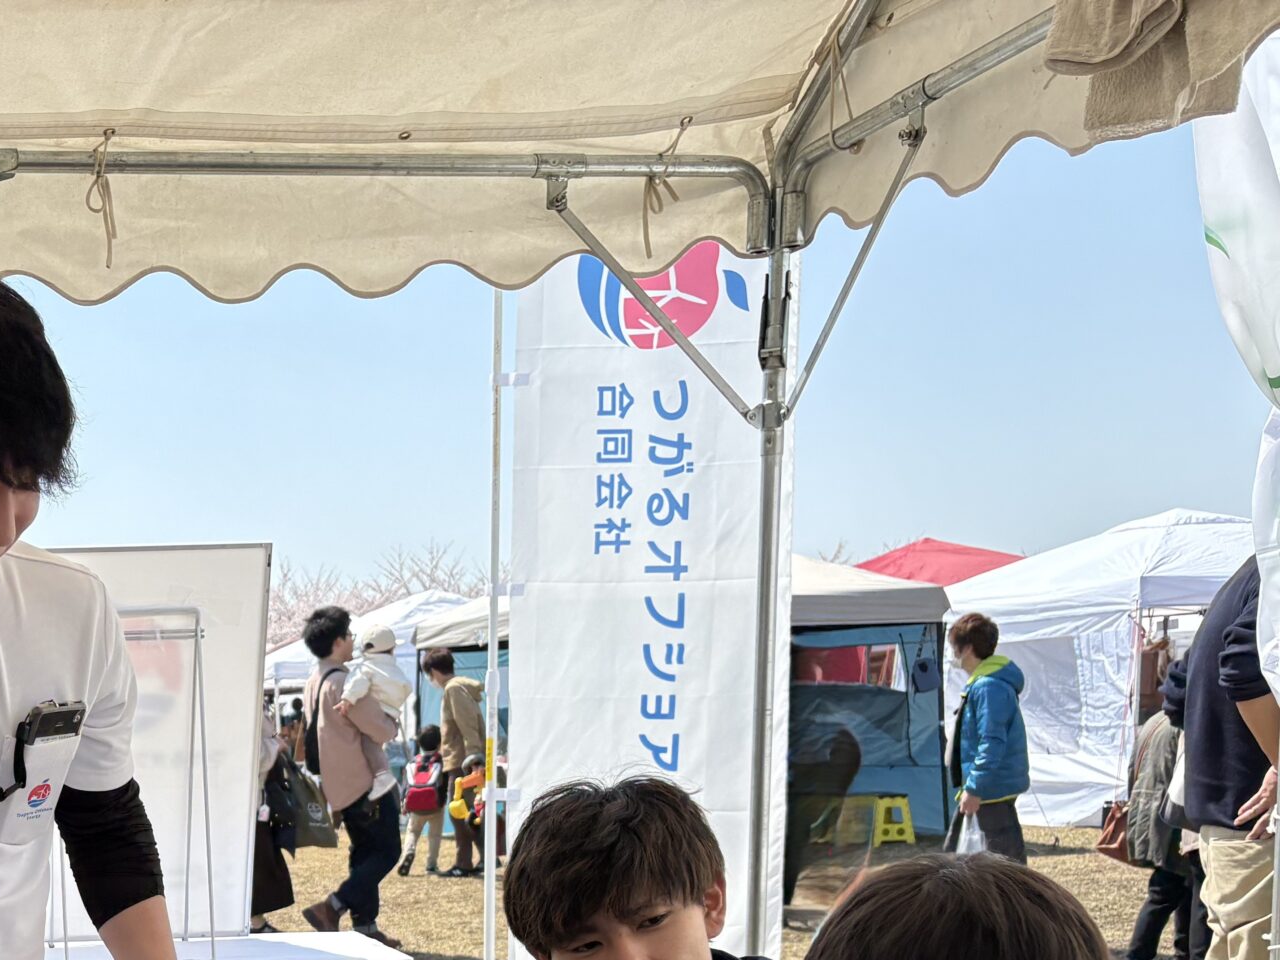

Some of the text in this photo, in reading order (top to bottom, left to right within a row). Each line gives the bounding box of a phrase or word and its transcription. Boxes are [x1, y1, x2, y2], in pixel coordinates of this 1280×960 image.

[594, 382, 635, 554] 合同会社
[639, 379, 694, 773] つがるオフショア
